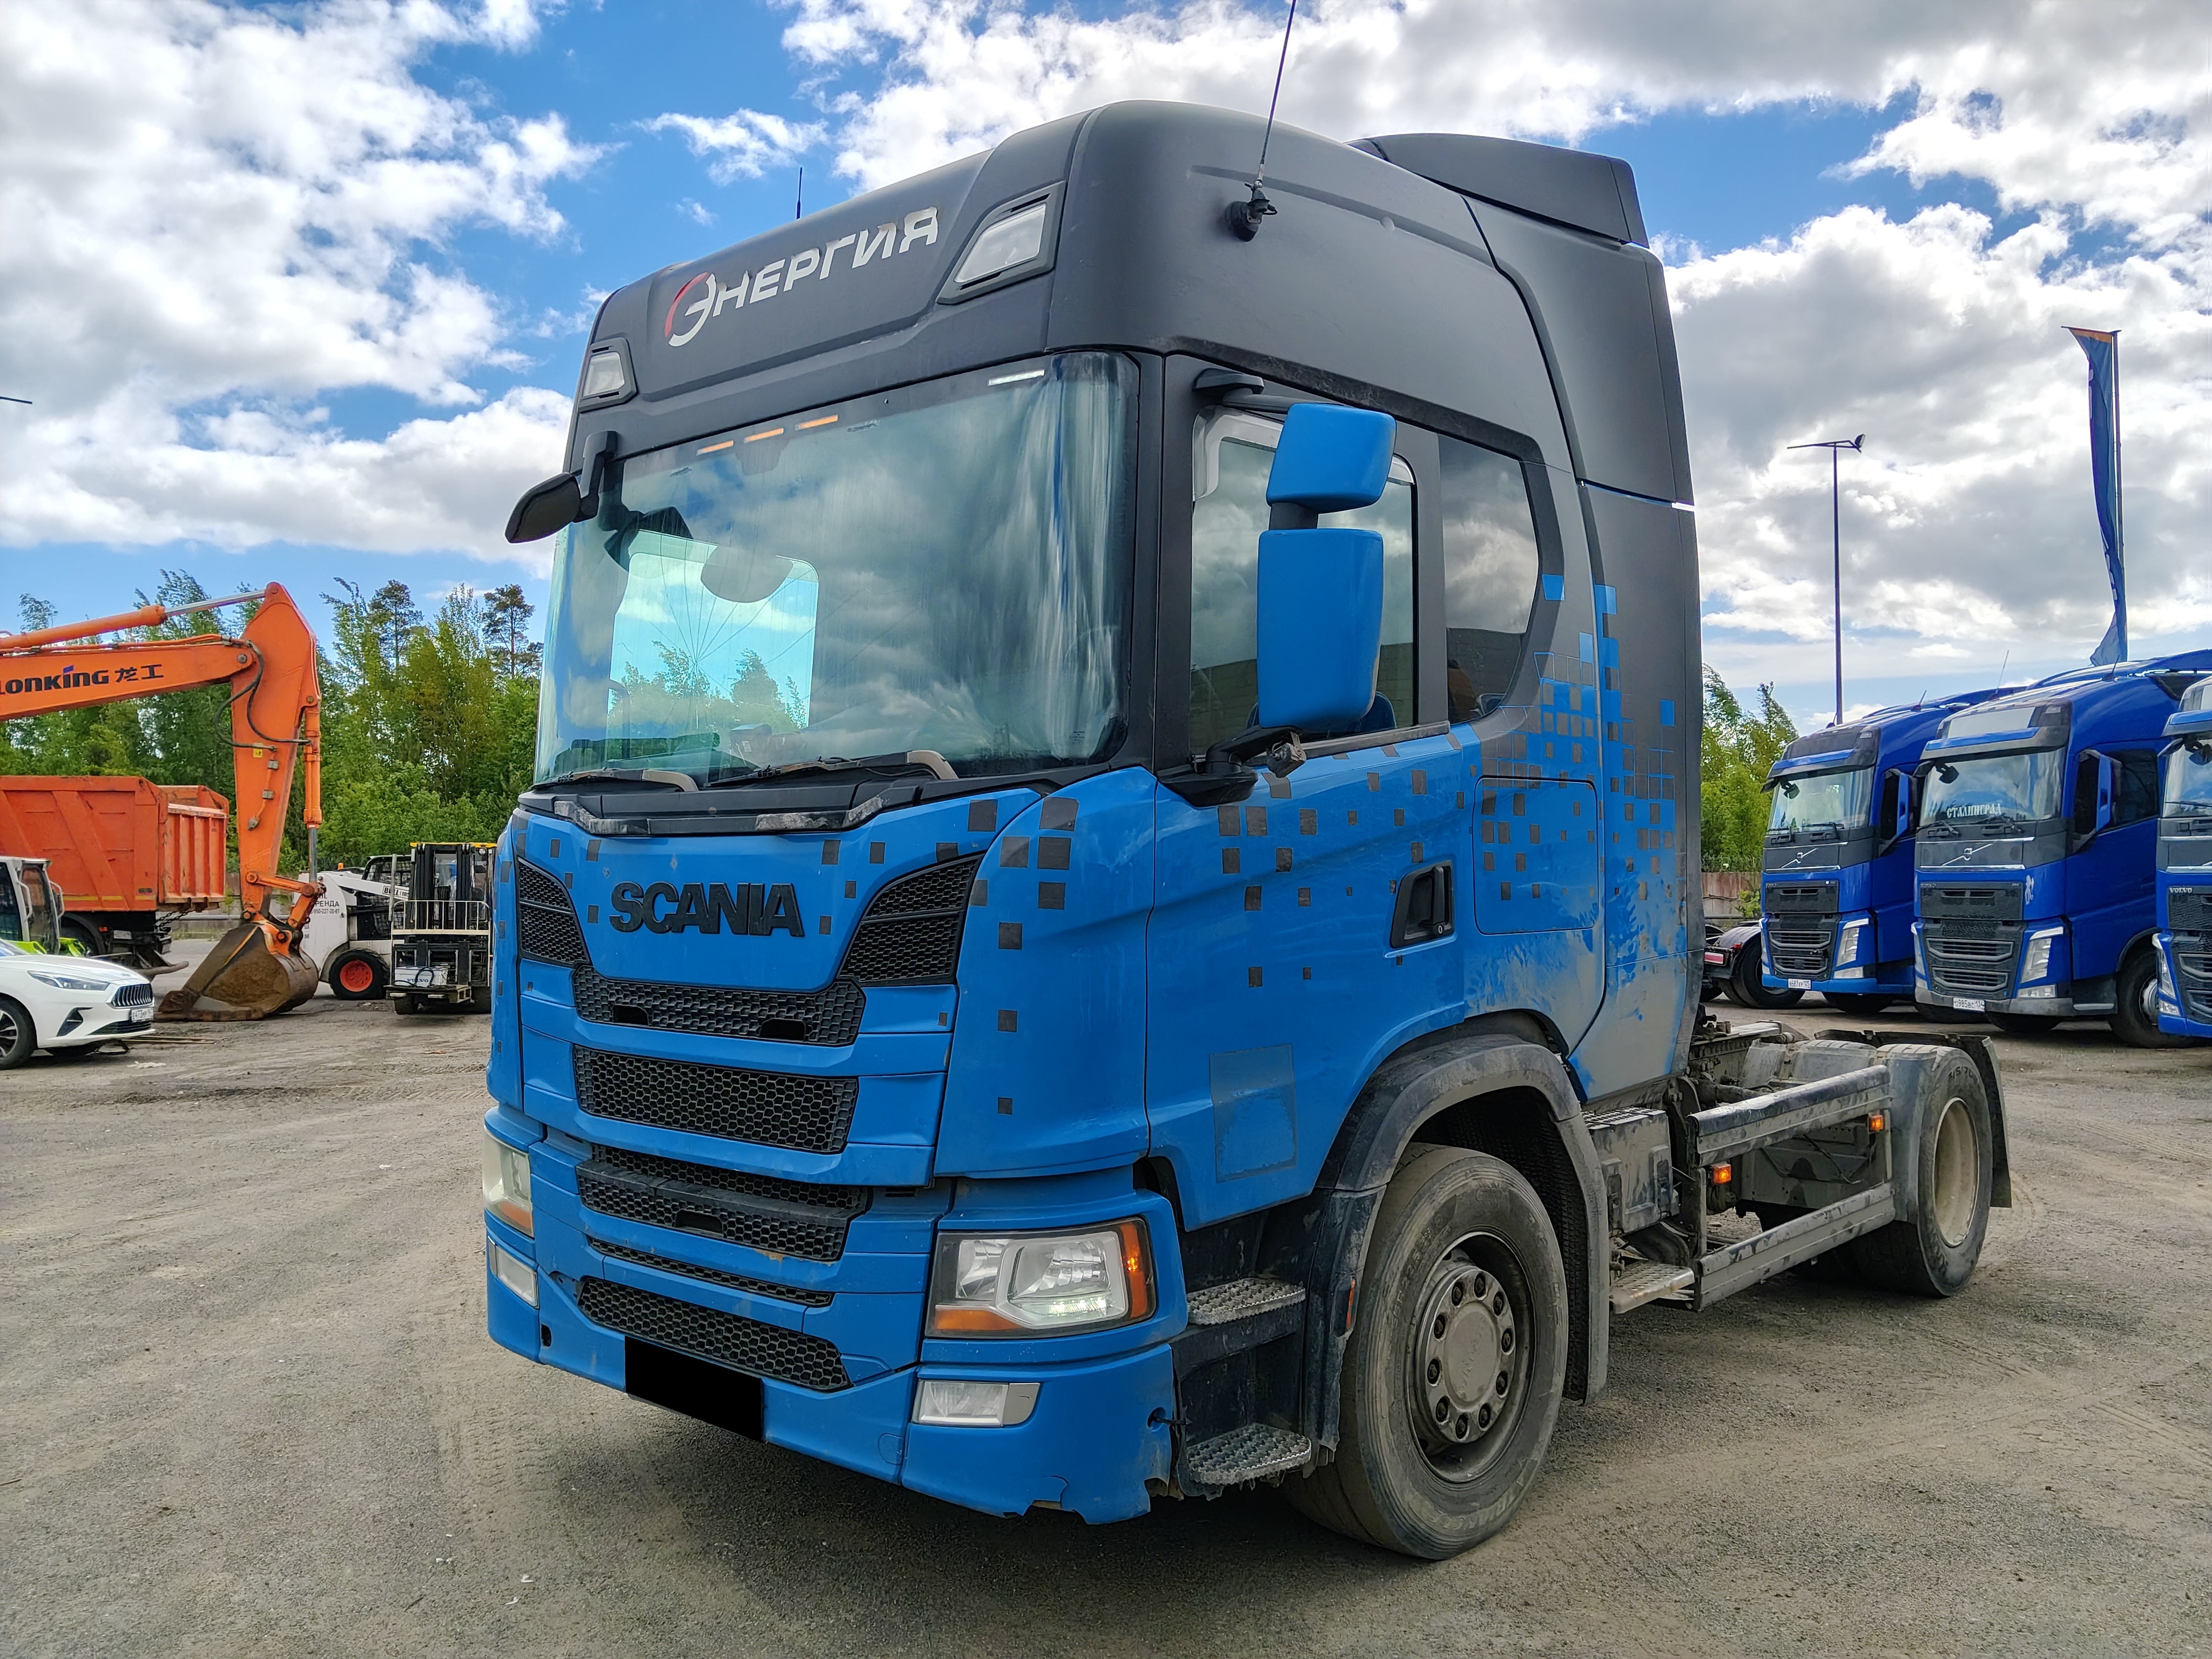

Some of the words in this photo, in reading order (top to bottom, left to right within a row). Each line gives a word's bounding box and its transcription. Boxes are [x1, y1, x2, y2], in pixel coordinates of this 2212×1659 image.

[665, 206, 939, 347] ЭНЕРГИЯ
[114, 664, 164, 683] 龙工
[1947, 803, 2001, 818] СТАЛИНГРАД
[609, 881, 805, 937] SCANIA
